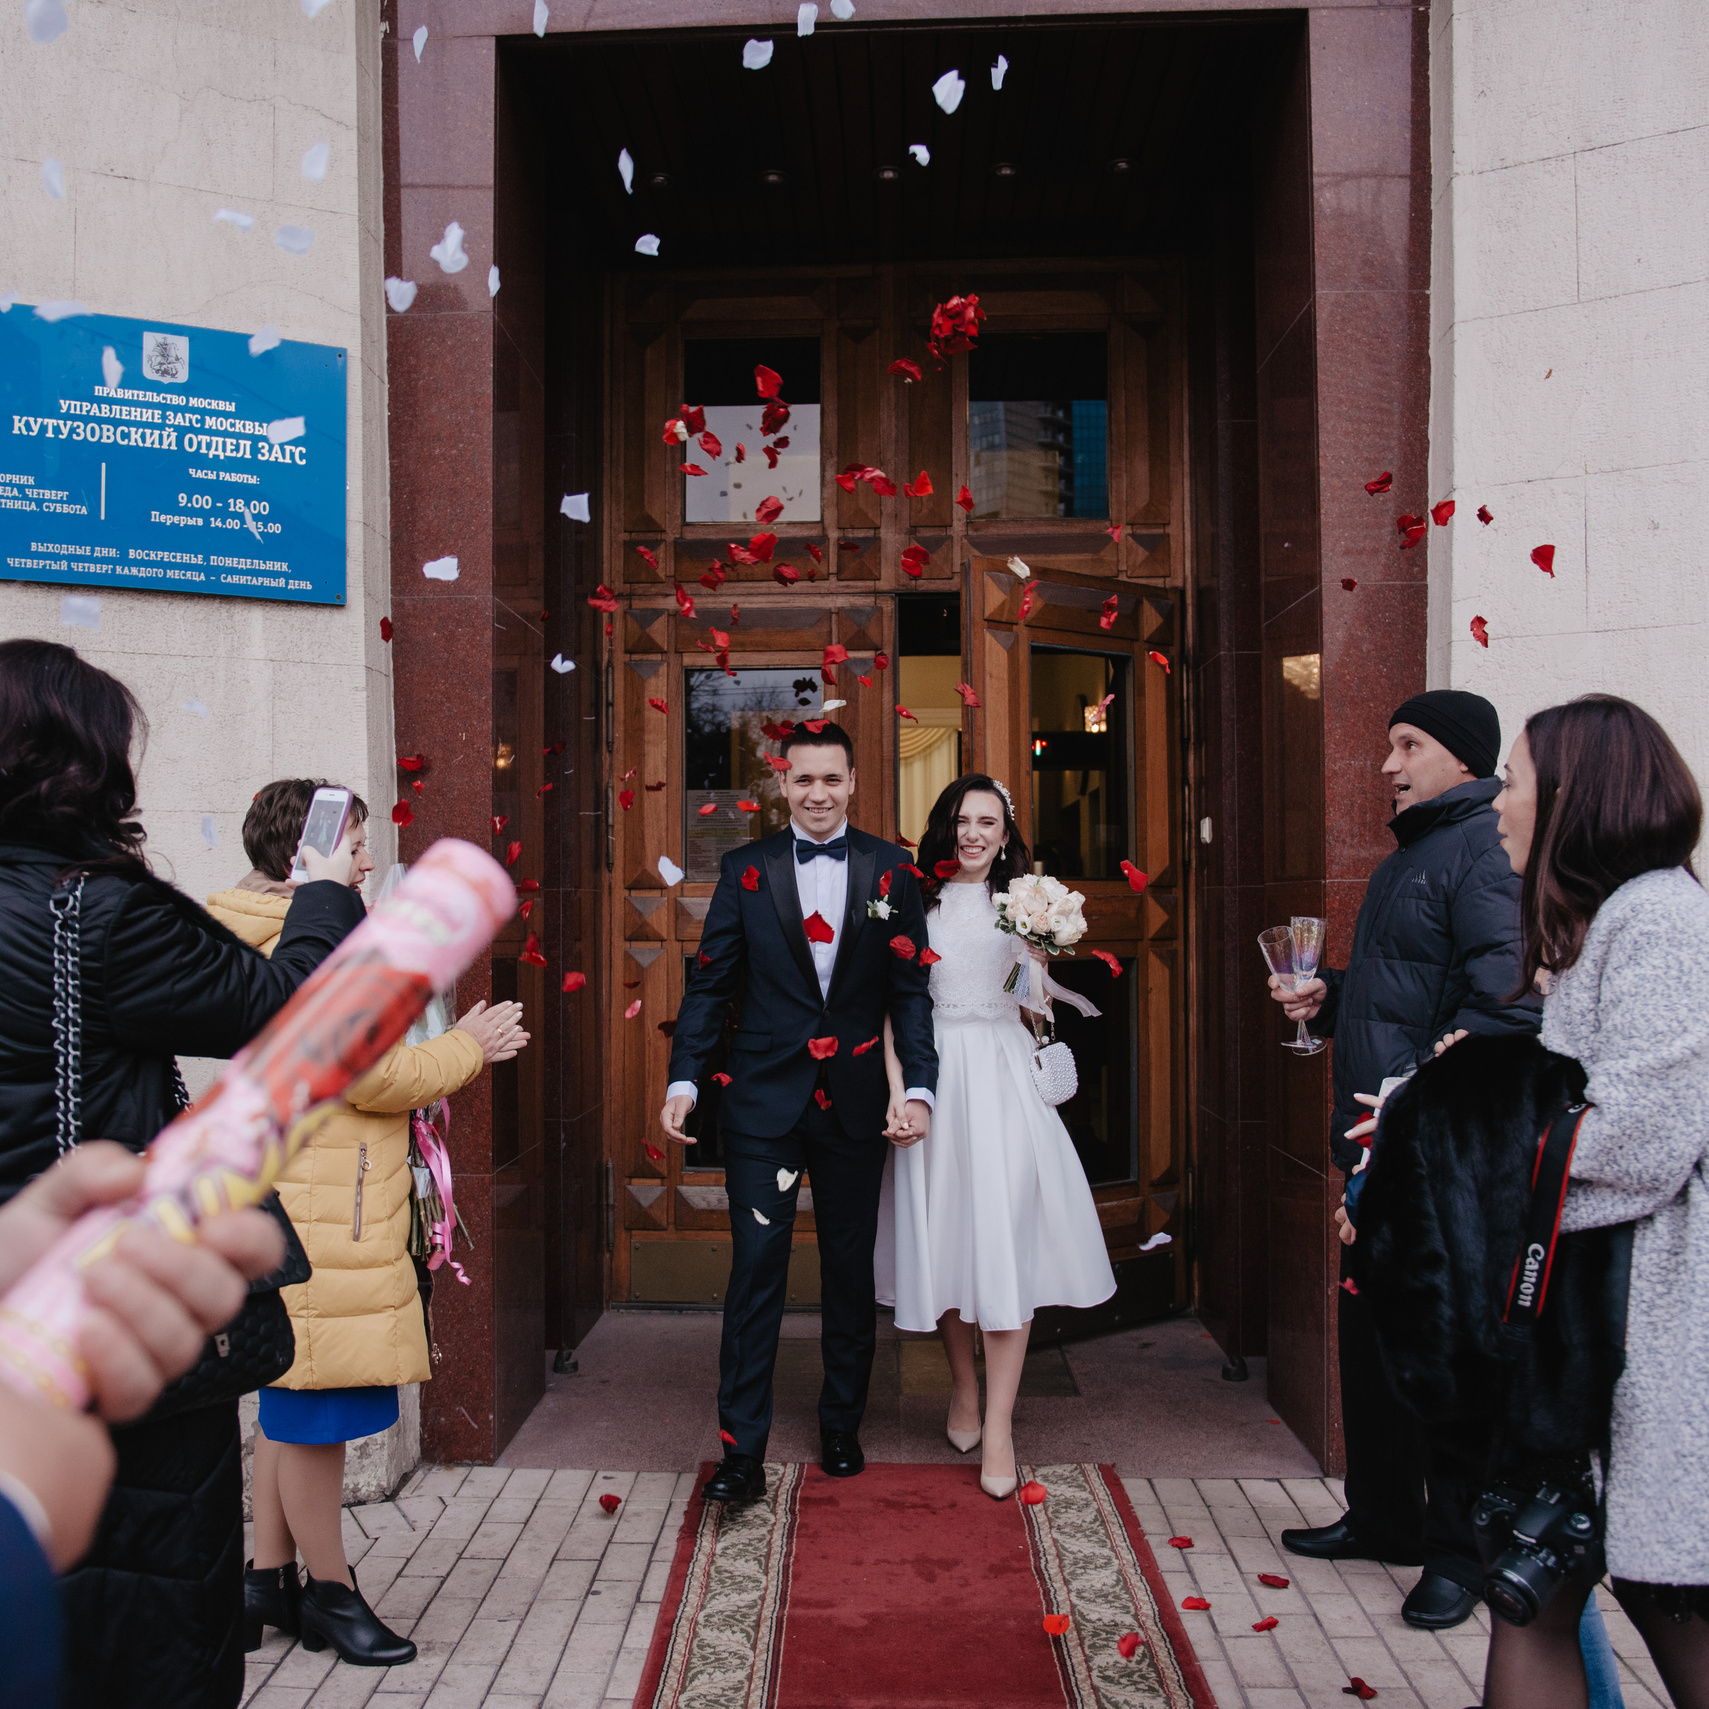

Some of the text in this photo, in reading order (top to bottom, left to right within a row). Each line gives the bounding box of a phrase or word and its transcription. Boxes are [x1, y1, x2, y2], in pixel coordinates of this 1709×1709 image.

[94, 386, 236, 412] ПРАВИТЕЛЬСТВО МОСКВЫ
[59, 399, 268, 436] УПРАВЛЕНИЕ ЗАГС МОСКВЫ
[12, 415, 307, 466] КУТУЗОВСКИЙ ОТДЕЛ ЗАГС
[188, 468, 260, 484] ЧАСЫ РАБОТЫ:
[25, 488, 70, 501] ЧЕТВЕРГ
[178, 492, 212, 510] 9.00
[227, 498, 270, 515] 1800
[42, 502, 88, 515] СУББОТА
[150, 511, 204, 526] Перерыв
[209, 517, 241, 530] 14.00
[30, 542, 292, 574] ВЫХОДНЫЕ ДНИ: ВОСКРЕСЕНЬЕ, ПОНЕДЕЛЬНИК,
[6, 558, 68, 571] ЧЕТВЕРТЫЙ
[70, 562, 114, 574] ЧЕТВЕРГ
[116, 565, 164, 578] КАЖДОГО
[166, 569, 206, 582] МЕСЯЦА
[220, 574, 286, 588] САНИТАРНЫЙ
[288, 580, 313, 590] ДЕНЬ
[1518, 1243, 1545, 1308] Canon
